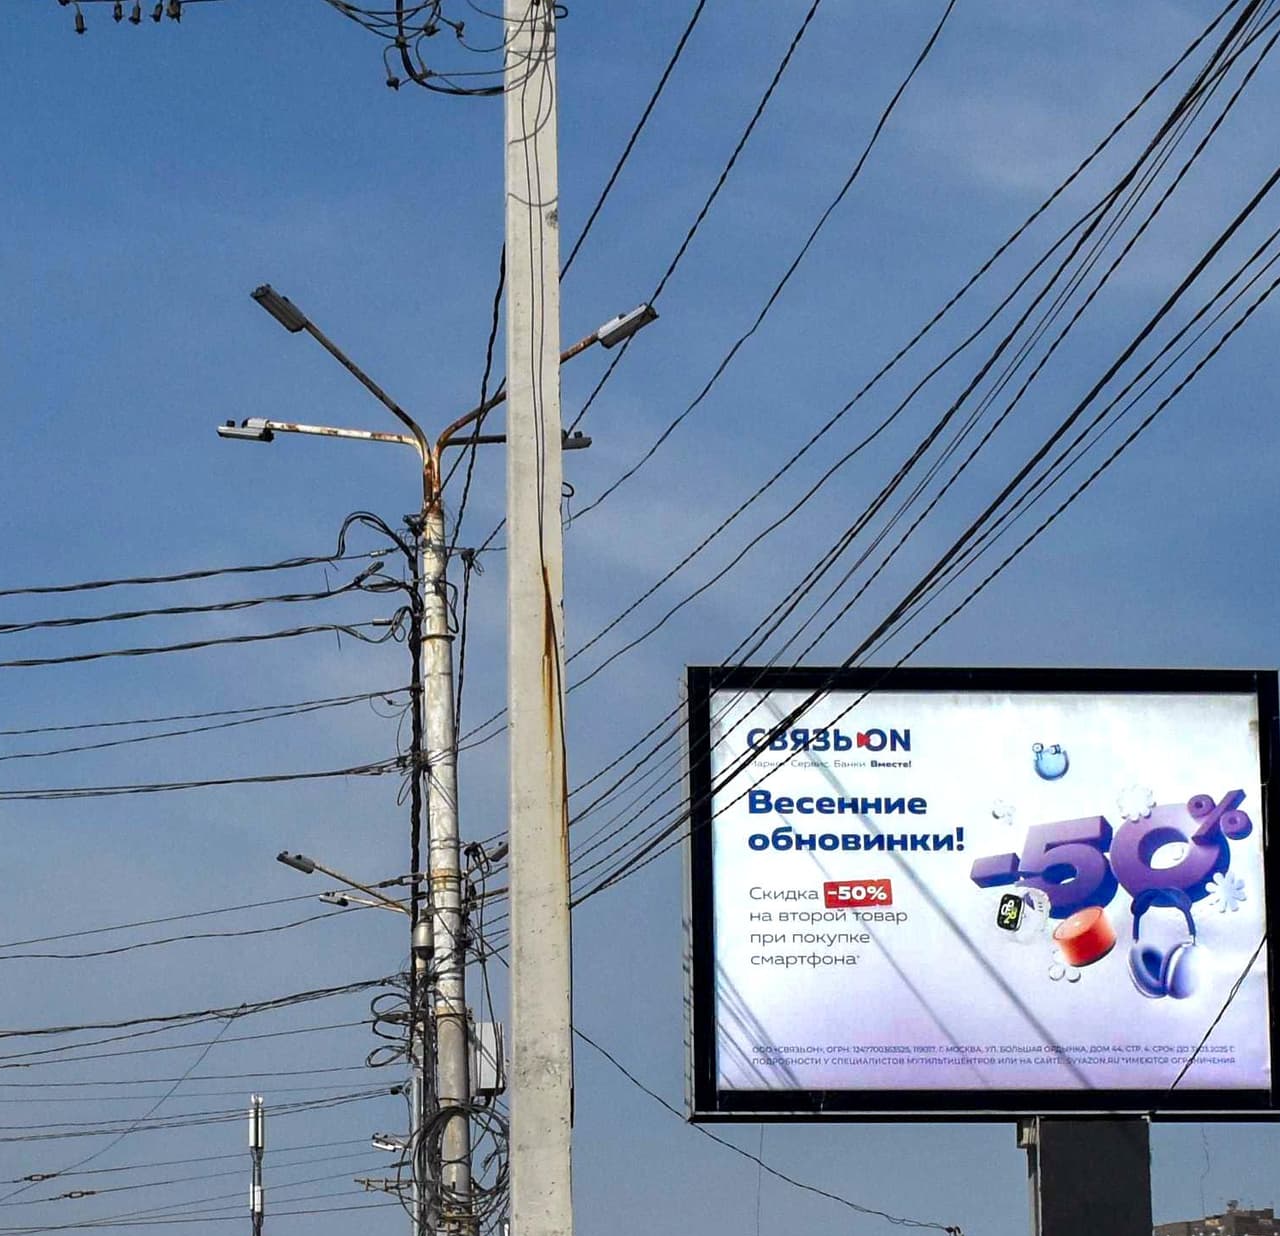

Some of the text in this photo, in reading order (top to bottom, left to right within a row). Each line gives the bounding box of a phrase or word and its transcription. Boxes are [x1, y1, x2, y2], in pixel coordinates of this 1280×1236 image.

[870, 759, 912, 768] Вместе!
[748, 789, 927, 814] Весенние
[748, 826, 965, 851] обновинки!
[970, 789, 1253, 920] -50%
[749, 885, 888, 901] Скидка -50%
[750, 909, 908, 925] на второй товар
[750, 933, 870, 947] при покупке
[1171, 1057, 1236, 1065] ОГРНИЧЕНИЯ
